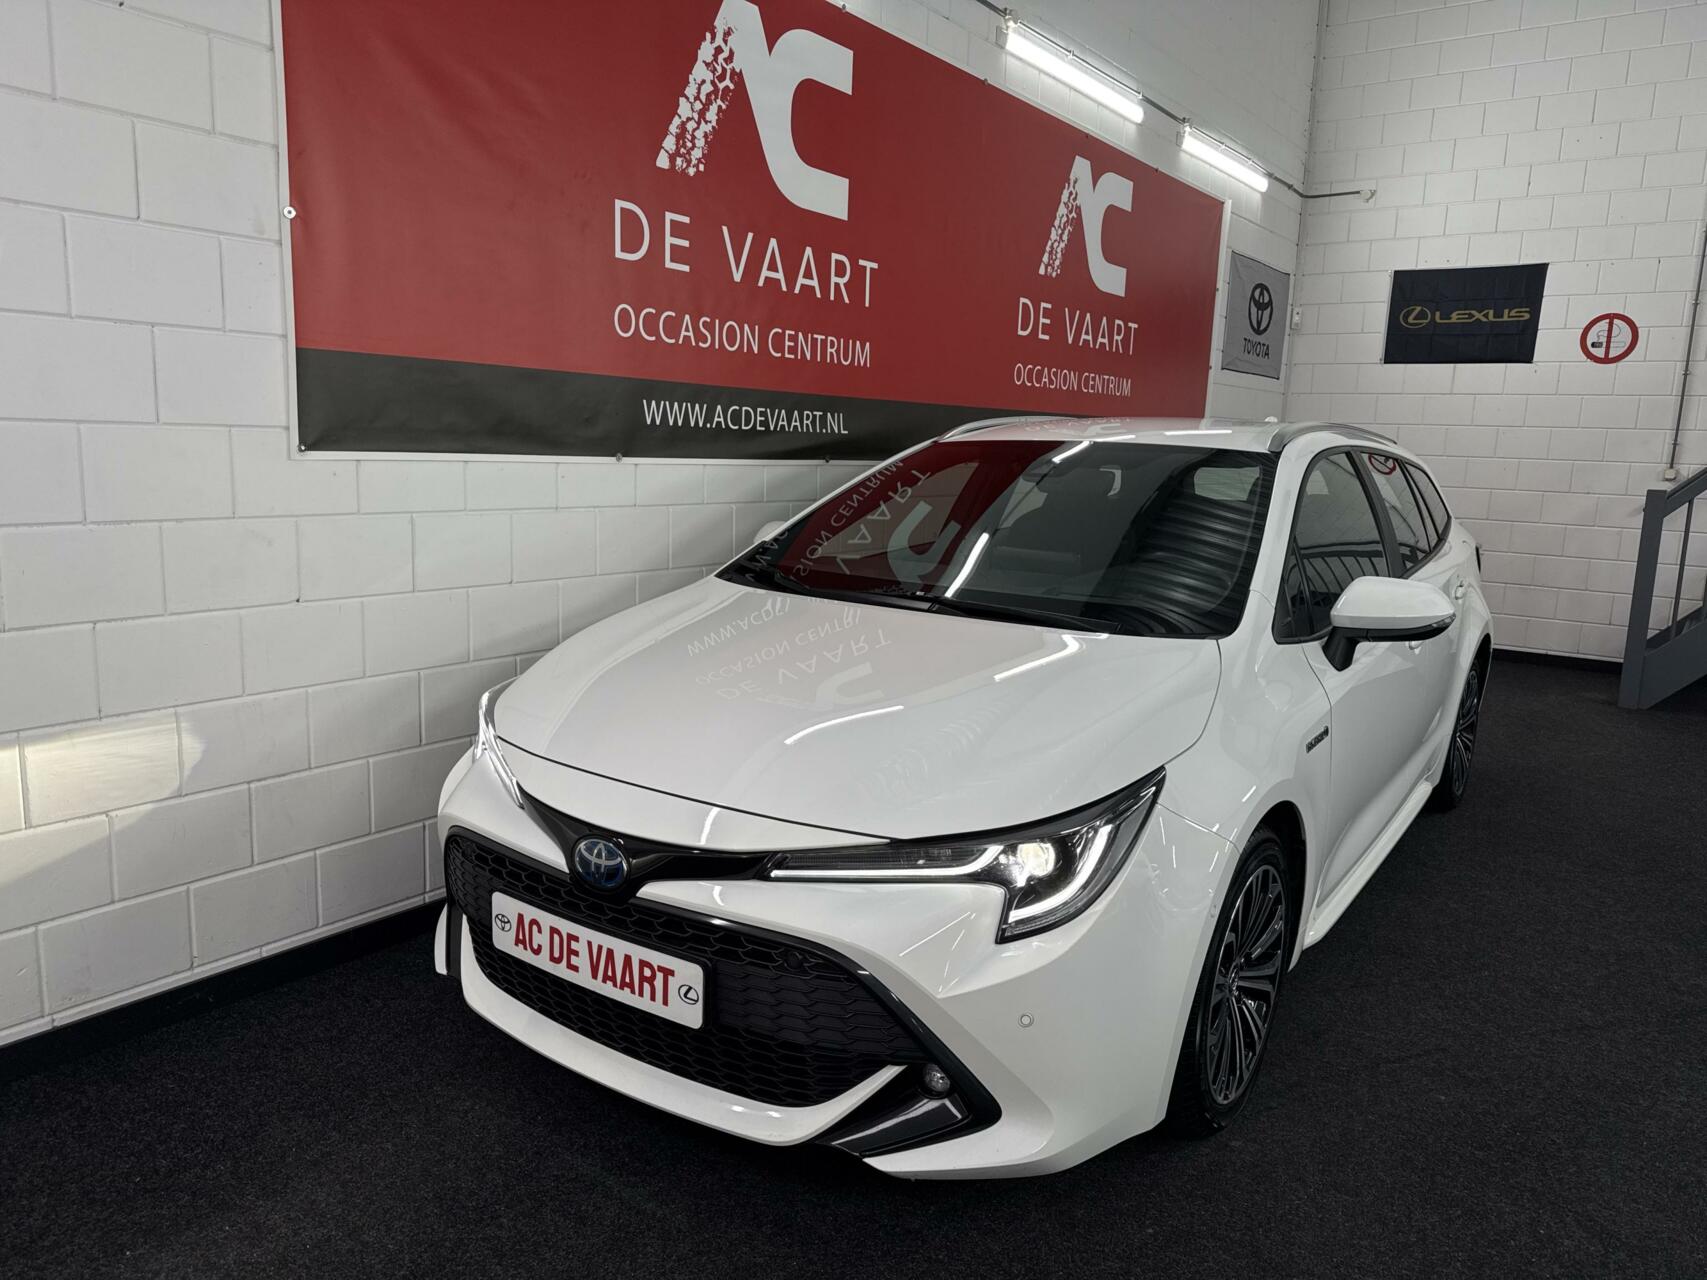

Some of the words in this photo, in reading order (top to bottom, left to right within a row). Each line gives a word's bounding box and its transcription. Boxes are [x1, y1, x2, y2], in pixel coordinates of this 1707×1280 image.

[614, 198, 691, 273] DE
[721, 225, 879, 308] VAART
[613, 303, 759, 354] OCCASION
[767, 327, 871, 368] CENTRUM
[1017, 297, 1052, 341] DE
[1064, 307, 1139, 356] VAART
[1434, 307, 1531, 323] LEXUS
[1243, 337, 1270, 360] TOYOTA
[1014, 363, 1078, 391] OCCASION
[1081, 372, 1132, 397] CENTRUM
[642, 399, 849, 434] WWW.ACDEVAART.NL
[514, 912, 543, 956] AC
[549, 925, 580, 974] DE
[586, 939, 675, 1007] VAART
